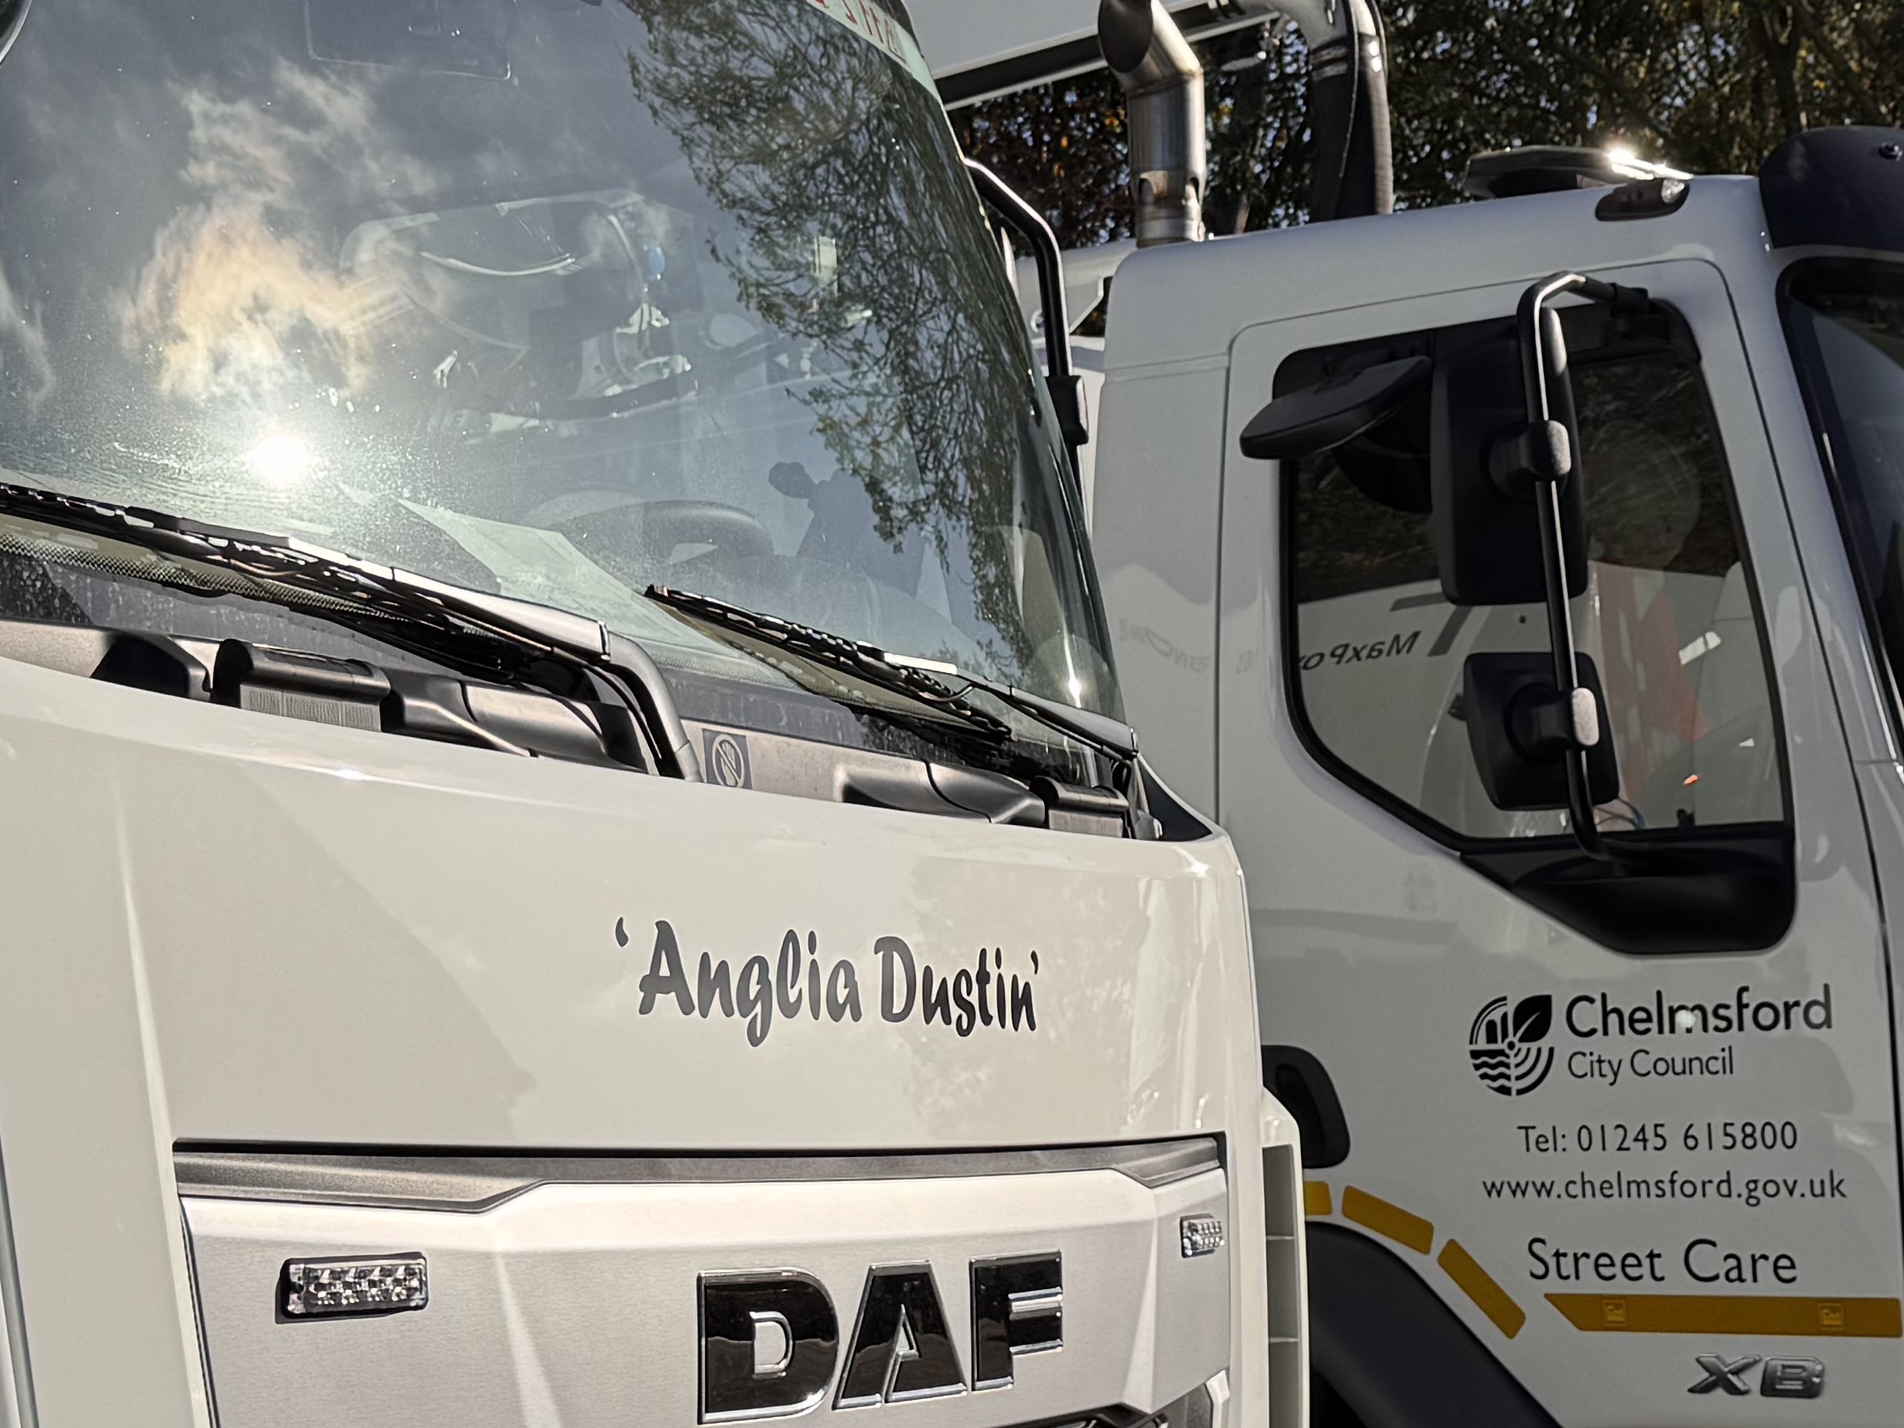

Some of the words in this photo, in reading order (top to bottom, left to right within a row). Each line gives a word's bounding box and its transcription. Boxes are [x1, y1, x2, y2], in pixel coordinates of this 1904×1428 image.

[1566, 984, 1831, 1037] Chelmsford
[1568, 1051, 1622, 1086] City
[1630, 1046, 1733, 1077] Council
[1517, 1126, 1566, 1152] Tel:
[1578, 1124, 1666, 1151] 01245
[1684, 1121, 1797, 1150] 615800
[1483, 1170, 1846, 1207] www.chelmsford.gov.uk
[1528, 1238, 1664, 1281] Street
[1684, 1239, 1796, 1283] Care
[696, 1249, 1063, 1425] DAF
[1687, 1352, 1826, 1399] XB
